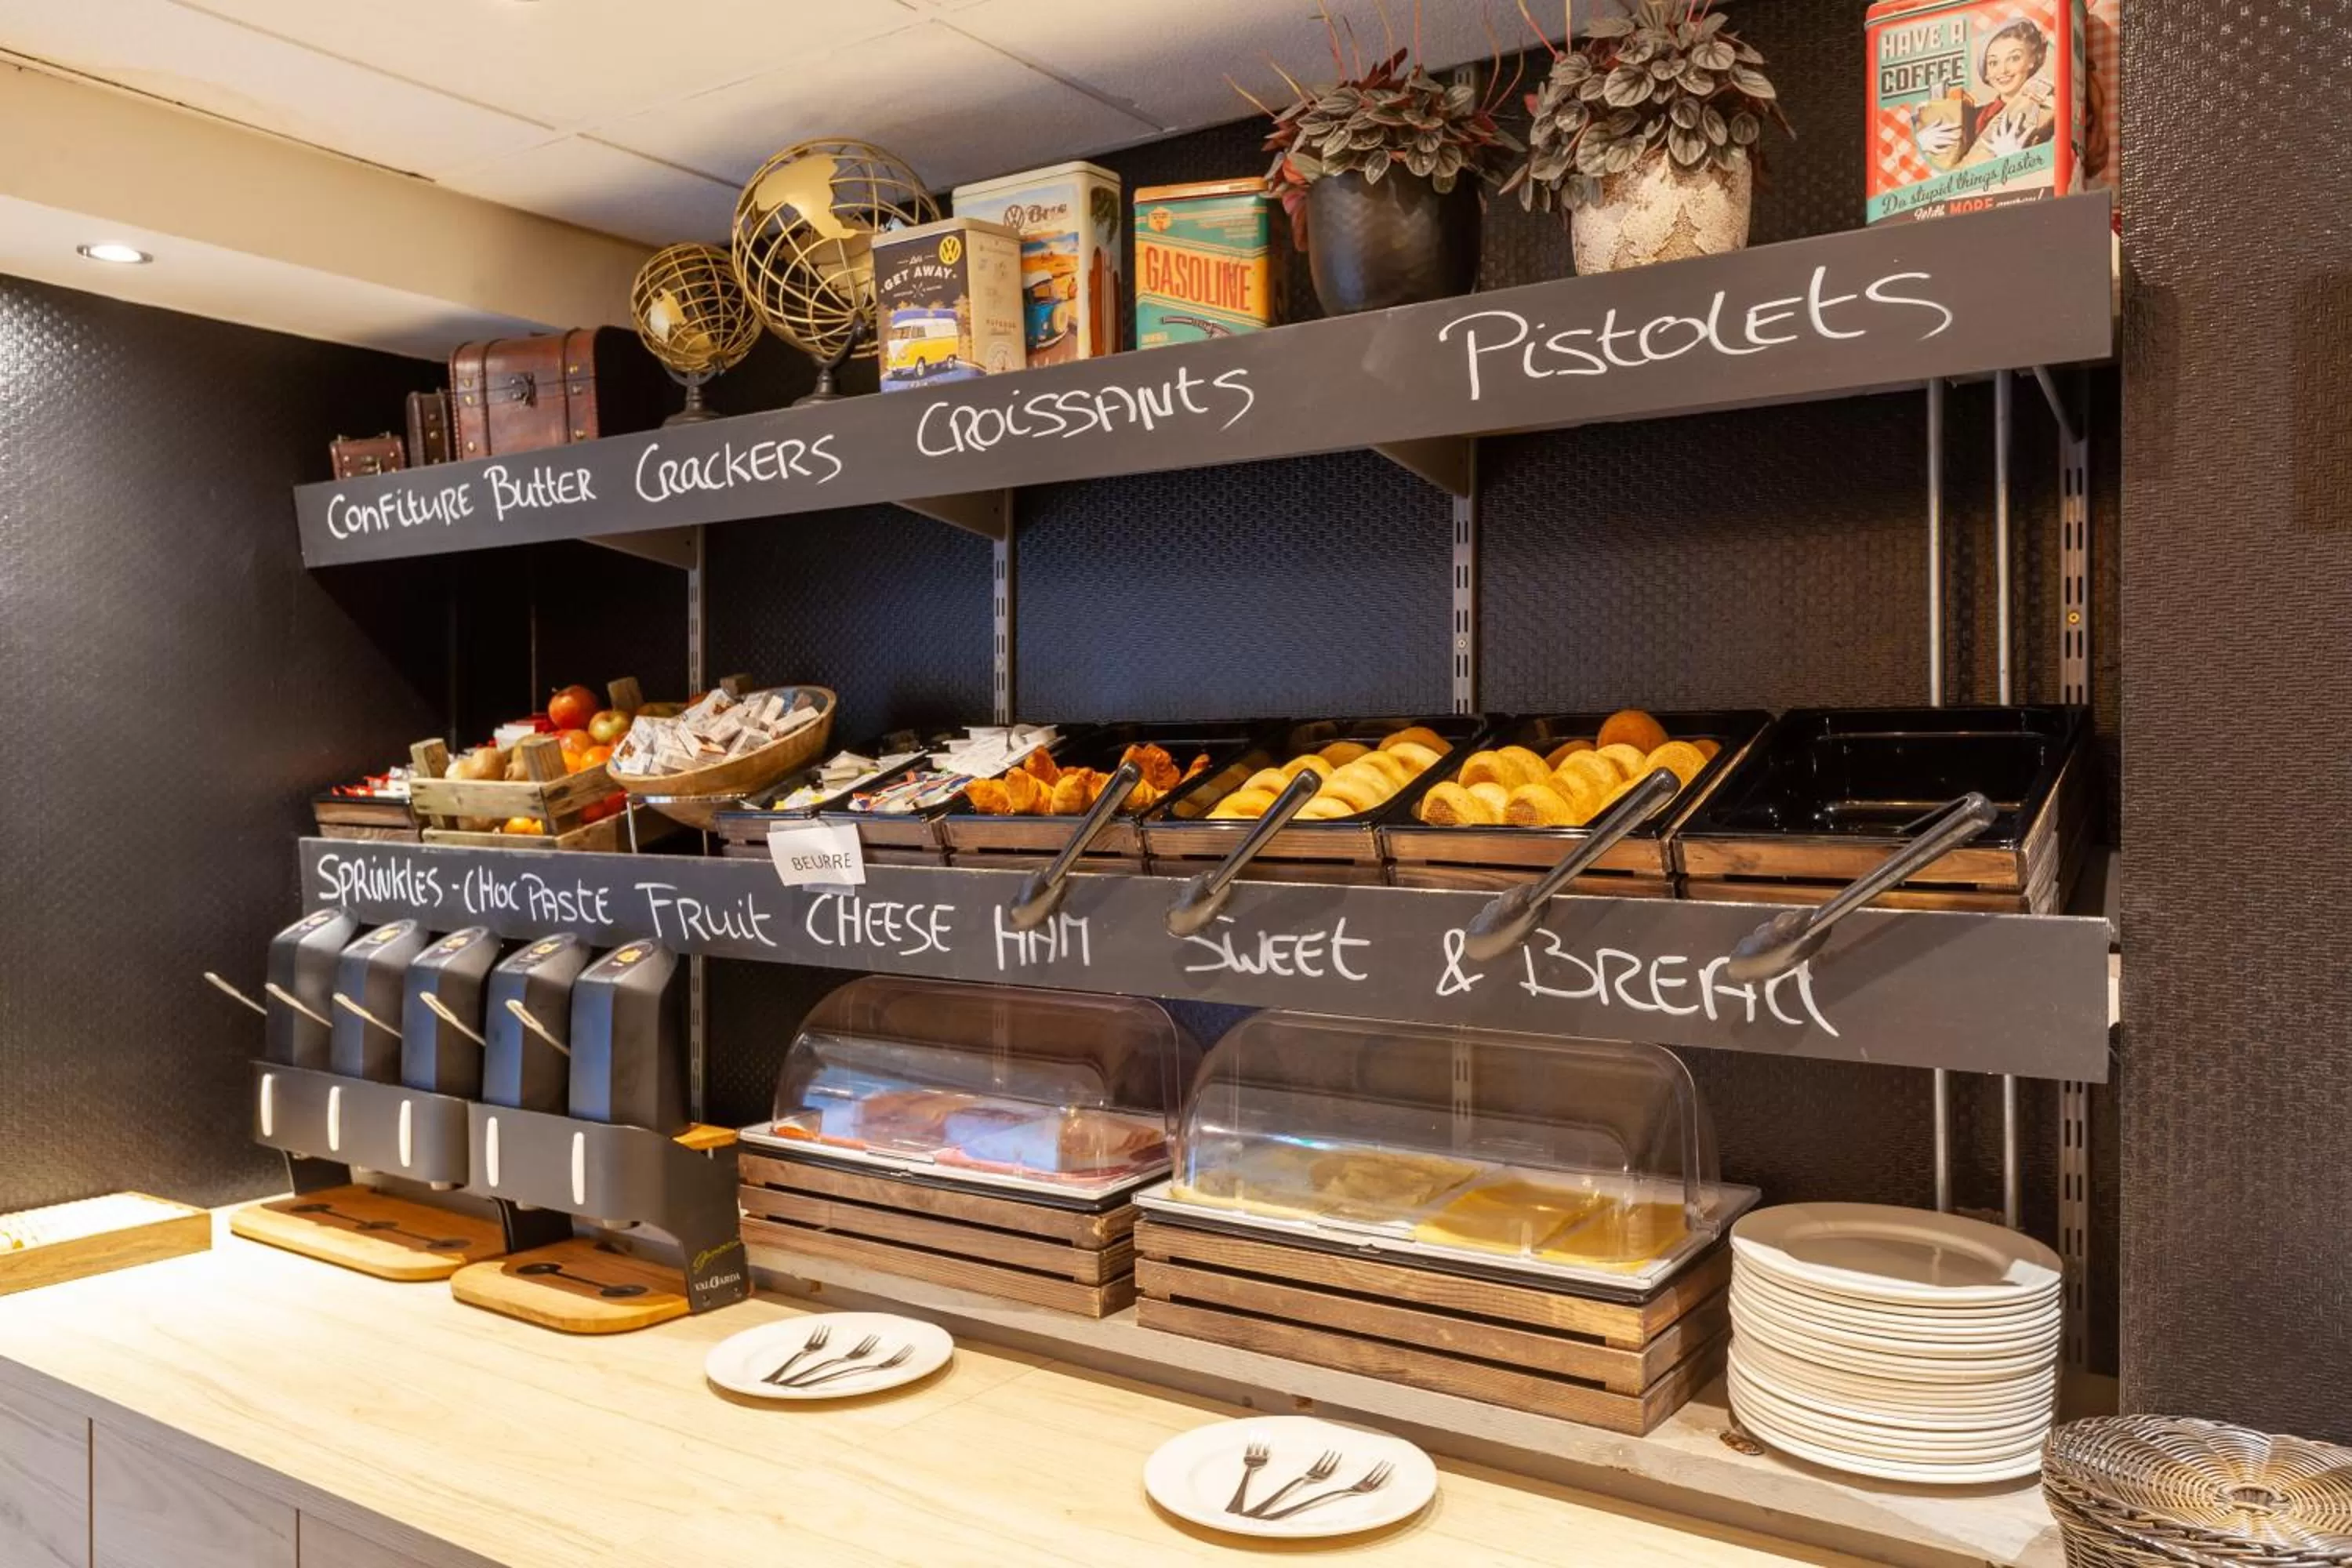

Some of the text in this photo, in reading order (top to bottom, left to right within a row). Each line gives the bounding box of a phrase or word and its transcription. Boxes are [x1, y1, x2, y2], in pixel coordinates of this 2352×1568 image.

[1881, 18, 1967, 60] HAVE A
[1881, 56, 1965, 95] COFFEE
[1882, 151, 2044, 215] Do stupid things faster
[883, 264, 953, 292] GET AWAY
[1145, 245, 1252, 312] GASOLINE
[792, 851, 853, 872] BEURRE
[805, 893, 956, 956] CHEESE
[1435, 927, 1486, 996] &
